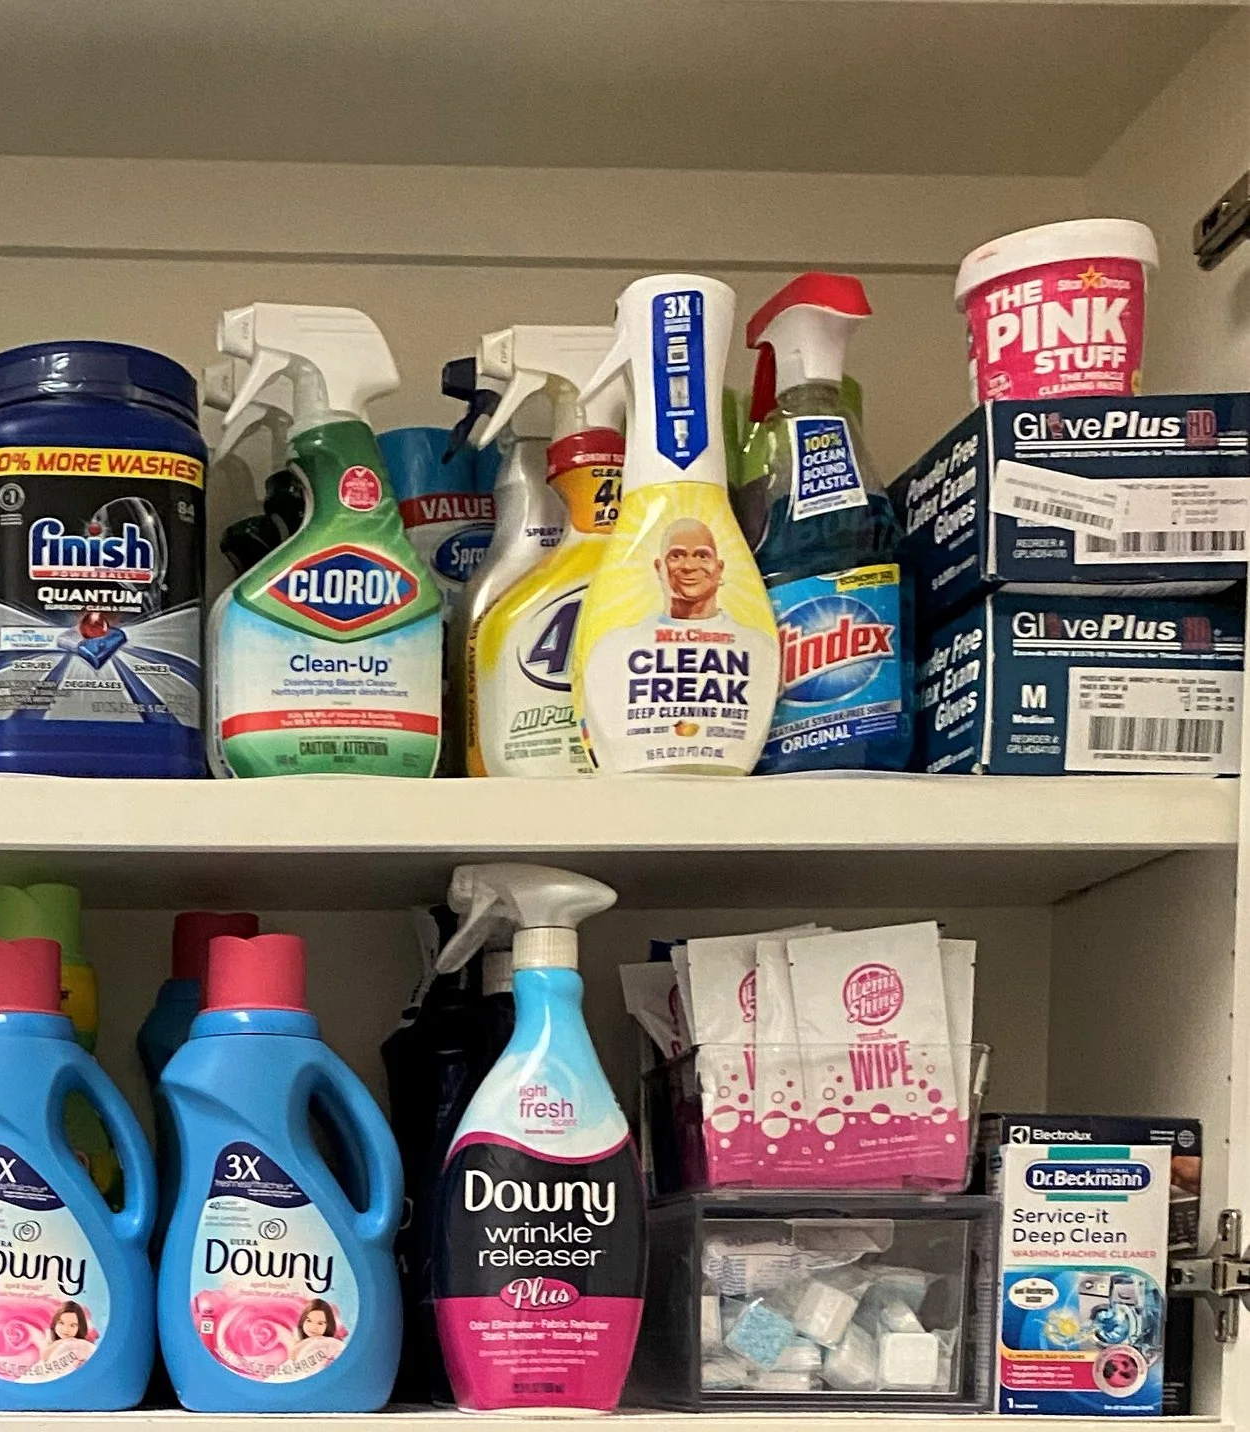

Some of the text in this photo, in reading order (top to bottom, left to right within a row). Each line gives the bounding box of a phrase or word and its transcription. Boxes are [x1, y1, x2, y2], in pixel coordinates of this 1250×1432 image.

[663, 295, 691, 318] 3X
[985, 279, 1043, 315] THE
[985, 296, 1129, 365] PINK
[1033, 344, 1128, 375] STUFF
[1038, 381, 1094, 396] CLEANING
[803, 432, 843, 453] 100%
[37, 452, 101, 473] MORE
[108, 454, 200, 482] WASHES
[802, 446, 846, 468] OCEAN
[591, 468, 623, 478] CLEA
[802, 461, 847, 482] BOUND
[801, 473, 855, 496] PLASTIC
[419, 497, 493, 520] VALUE
[934, 499, 977, 545] Gloves
[30, 519, 153, 569] finish
[37, 586, 143, 605] QUANTUM
[287, 568, 402, 606] CLOROX
[13, 661, 53, 670] SCRUBS
[134, 664, 169, 673] SHINES
[289, 654, 389, 676] Clean-Up
[627, 647, 750, 677] CLEAN
[64, 680, 123, 689] DEGREASES
[628, 677, 749, 705] FREAK
[1020, 684, 1048, 709] M
[510, 707, 540, 732] All
[627, 706, 749, 720] DEEP CLEANING MIST
[934, 690, 979, 732] Gloves
[1011, 713, 1055, 724] Medium
[780, 723, 852, 754] ORIGINAL
[848, 967, 897, 999] Lemi
[846, 990, 902, 1024] Shine
[848, 1040, 915, 1092] WIPE
[519, 1084, 548, 1098] light
[519, 1097, 574, 1118] fresh
[551, 1118, 578, 1126] scent
[859, 1138, 876, 1147] Use
[1032, 1128, 1092, 1141] Electrolux
[223, 1153, 263, 1181] 3X
[1054, 1169, 1143, 1187] Beckmann
[464, 1169, 617, 1226] Downy
[1012, 1208, 1110, 1224] Service-it
[230, 1238, 259, 1247] ULTRA
[484, 1221, 593, 1244] wrinkle
[1012, 1227, 1128, 1246] Deep Clean
[478, 1247, 602, 1267] releaser
[1012, 1250, 1157, 1259] WASHING MACHINE CLEANER
[205, 1238, 334, 1295] Downy
[506, 1276, 571, 1309] Plus
